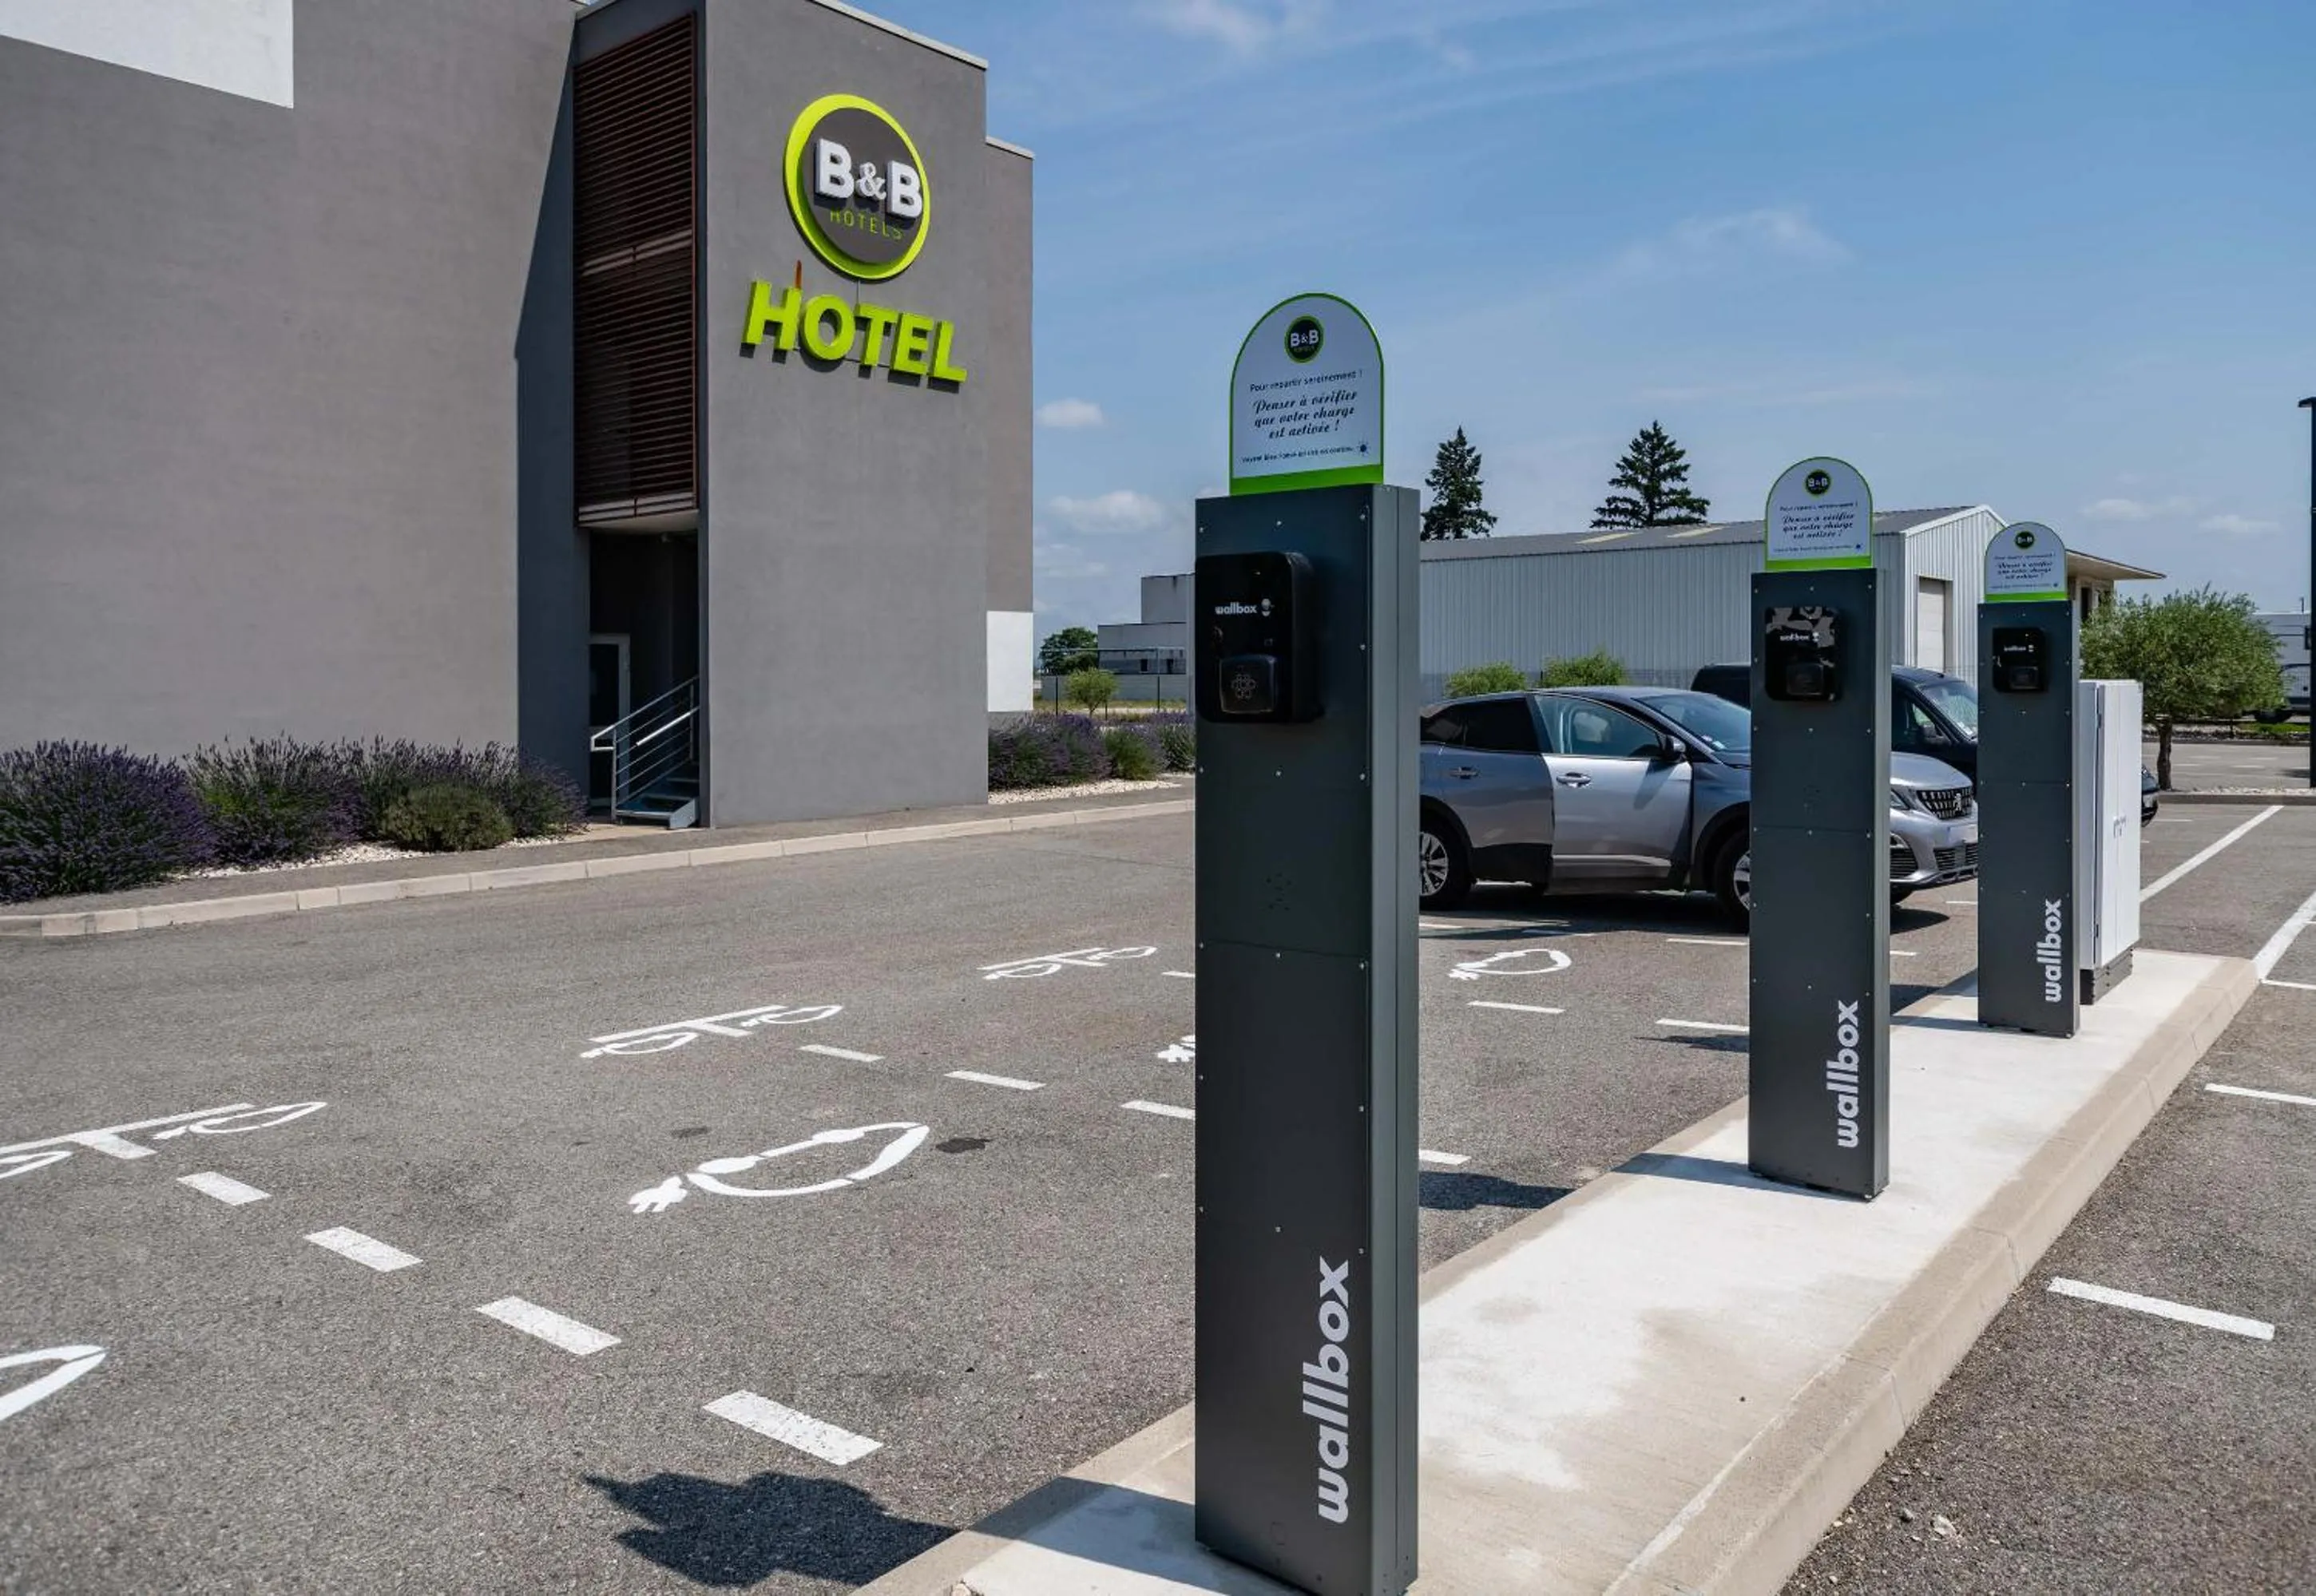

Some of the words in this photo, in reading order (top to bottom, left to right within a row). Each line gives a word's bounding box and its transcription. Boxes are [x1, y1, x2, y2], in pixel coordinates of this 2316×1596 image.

[814, 138, 923, 219] B&B
[830, 208, 903, 240] HOTELS
[742, 279, 968, 383] HOTEL
[1291, 329, 1319, 348] B&B
[1313, 406, 1355, 419] charge
[1215, 602, 1258, 615] wallbox
[2036, 898, 2062, 1003] wallbox
[1826, 1000, 1859, 1148] wallbox
[1303, 1255, 1350, 1524] wallbox
